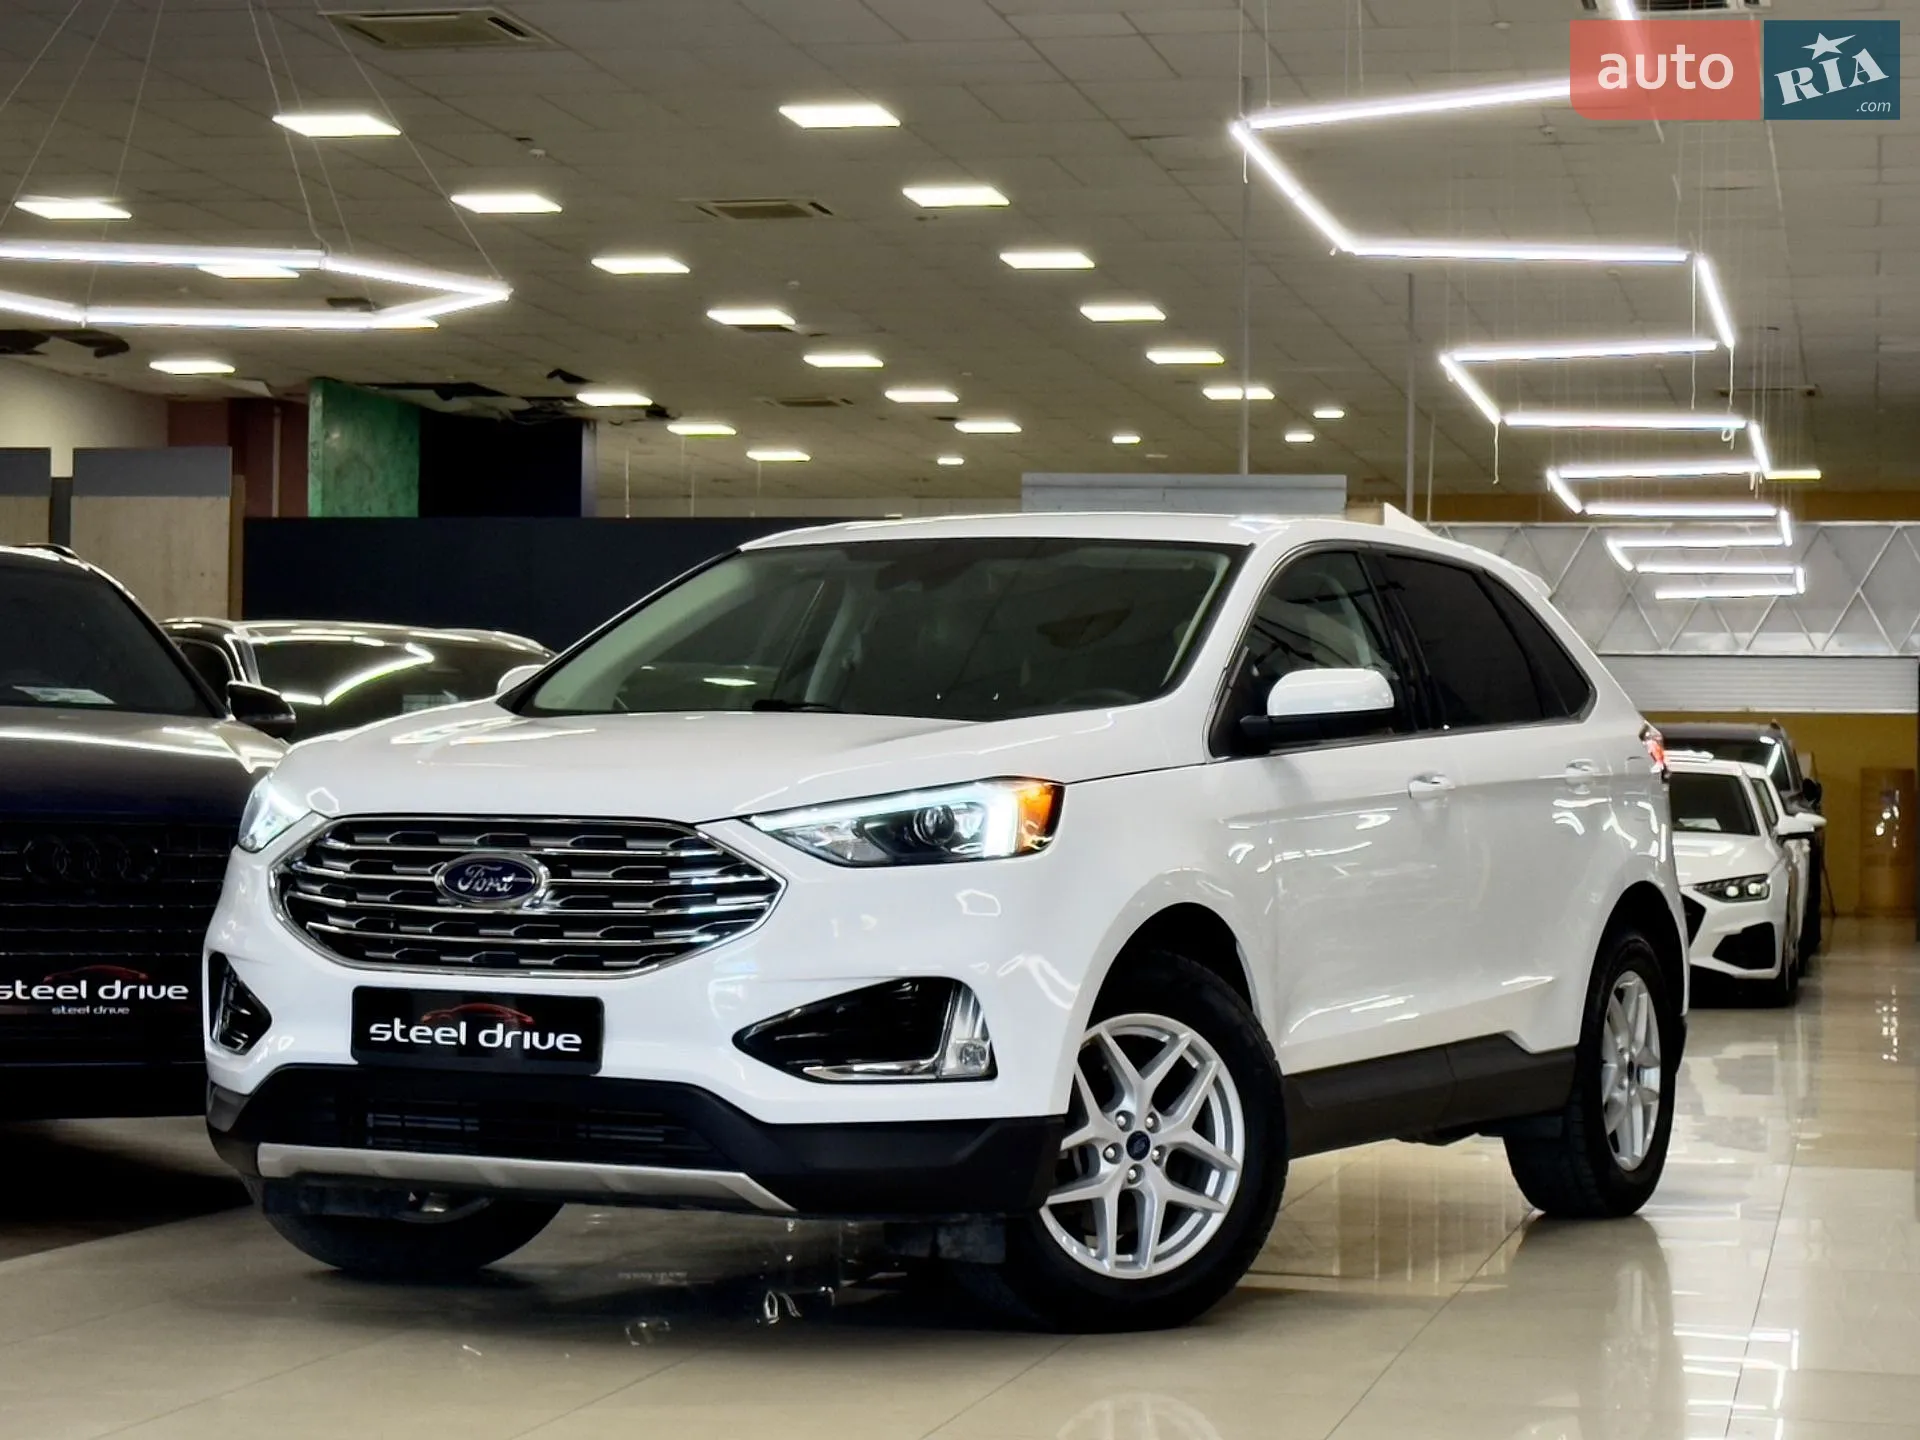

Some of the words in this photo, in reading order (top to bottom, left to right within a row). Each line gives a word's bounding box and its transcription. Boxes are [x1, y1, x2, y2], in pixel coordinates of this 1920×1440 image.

[457, 863, 517, 893] Ford
[98, 979, 190, 1001] drive
[51, 1005, 91, 1016] steel
[93, 1005, 130, 1016] drive
[369, 1017, 468, 1046] steel
[478, 1022, 583, 1053] drive
